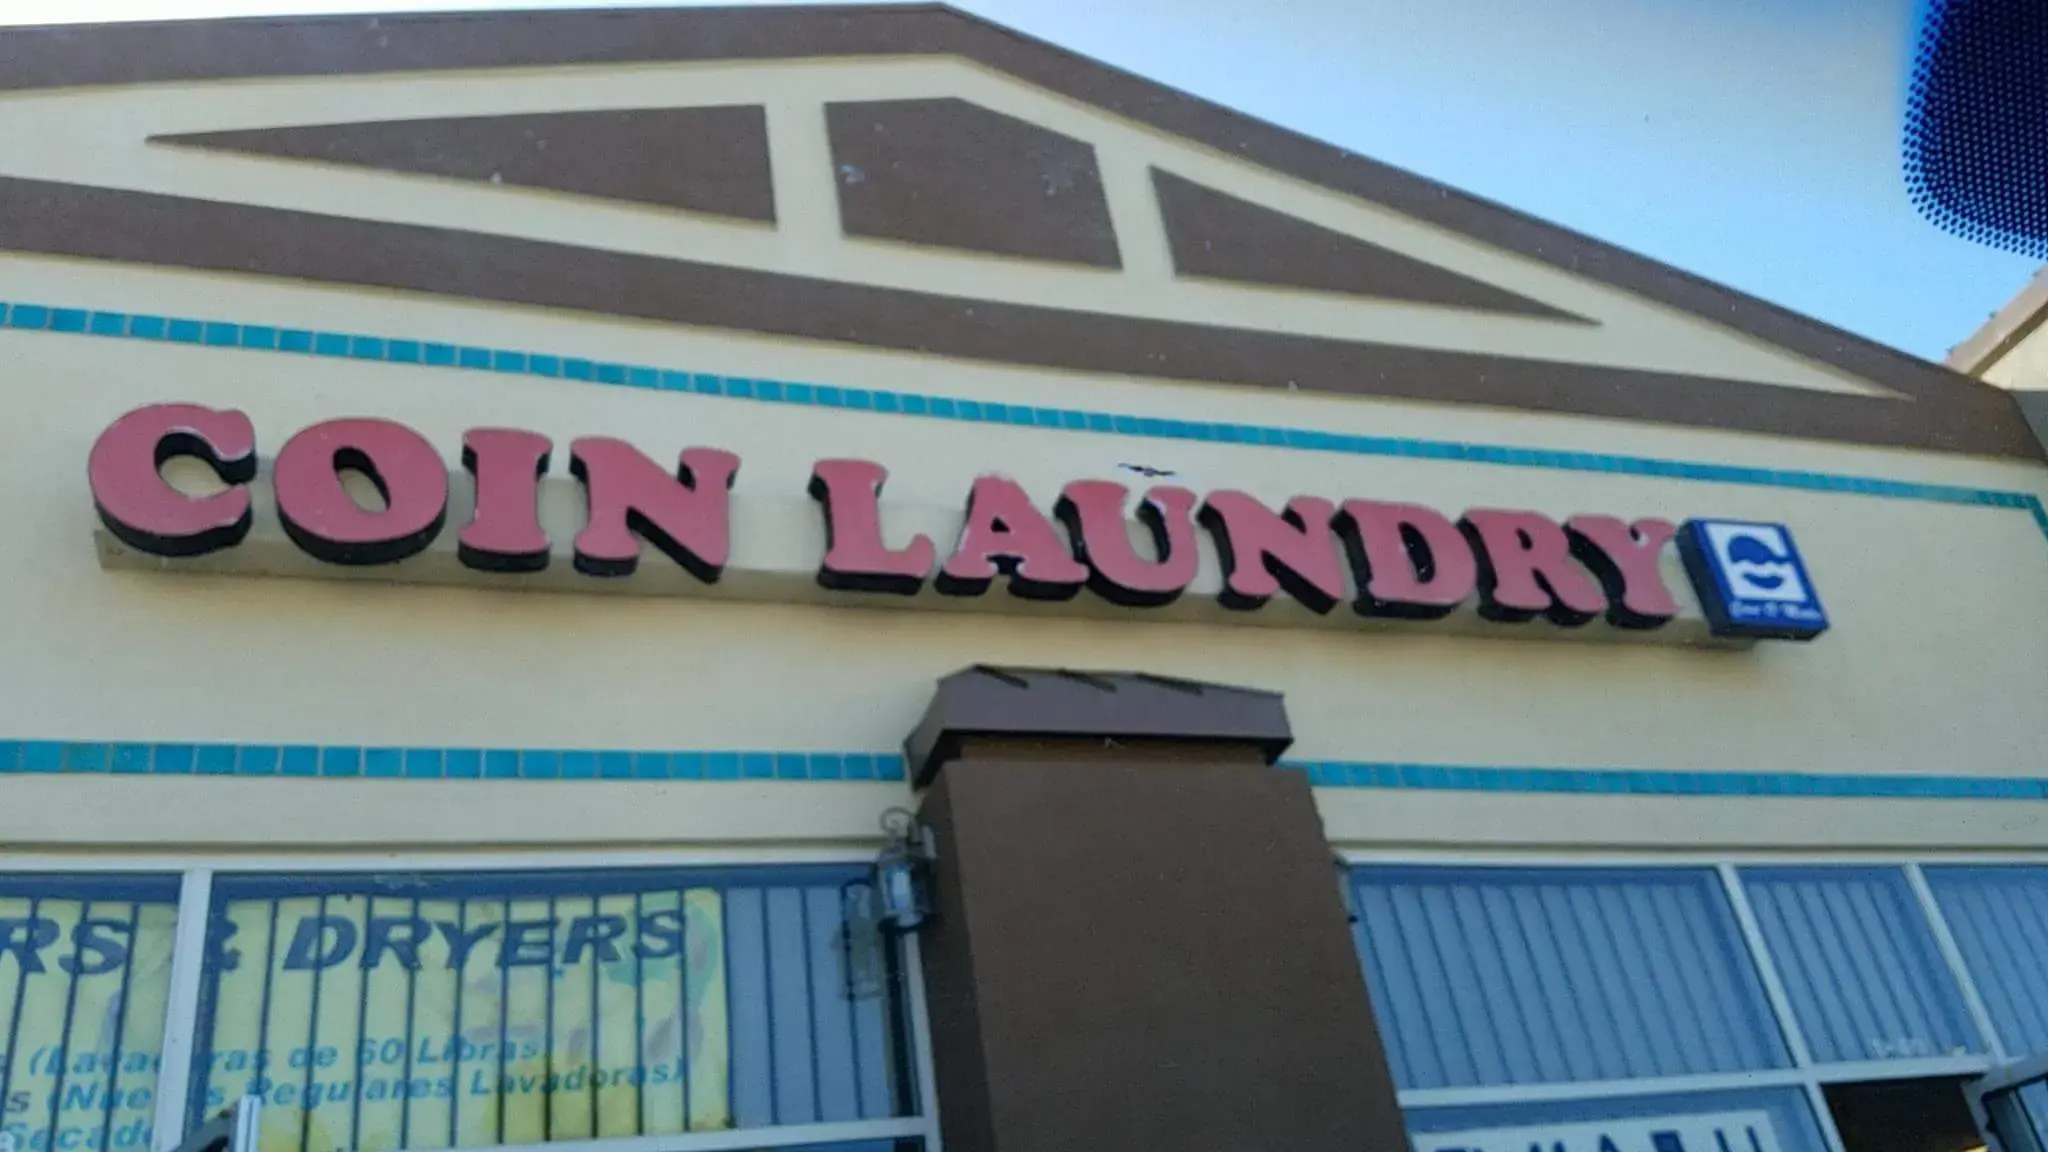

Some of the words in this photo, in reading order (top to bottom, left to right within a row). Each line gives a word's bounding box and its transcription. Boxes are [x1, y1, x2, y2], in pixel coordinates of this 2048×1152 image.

[88, 402, 741, 584] COIN
[808, 457, 1683, 631] LAUNDRY
[283, 907, 689, 972] DRYERS
[287, 1043, 338, 1069] de
